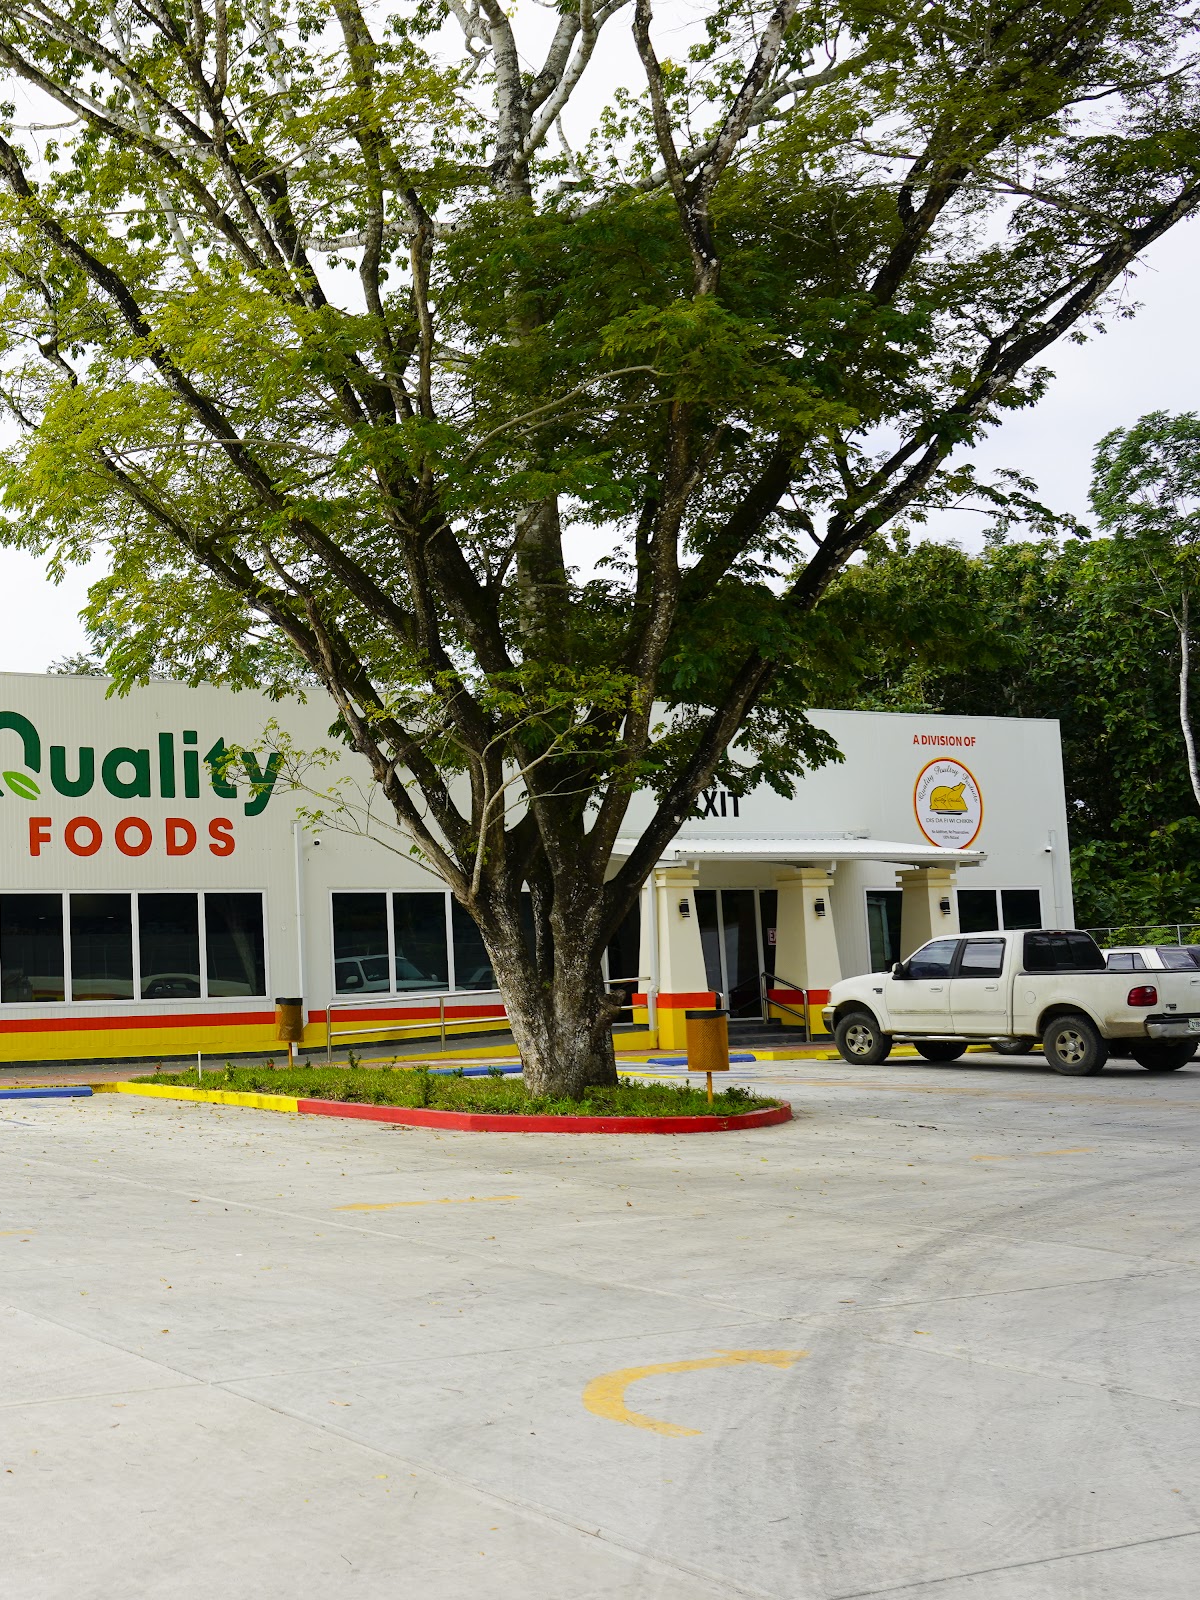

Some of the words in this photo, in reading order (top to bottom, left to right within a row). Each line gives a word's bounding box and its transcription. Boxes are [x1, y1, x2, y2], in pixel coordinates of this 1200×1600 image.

[913, 734, 920, 745] A
[921, 735, 963, 746] DIVISION
[963, 736, 976, 747] OF
[688, 790, 740, 817] XIT
[29, 816, 235, 857] FOODS
